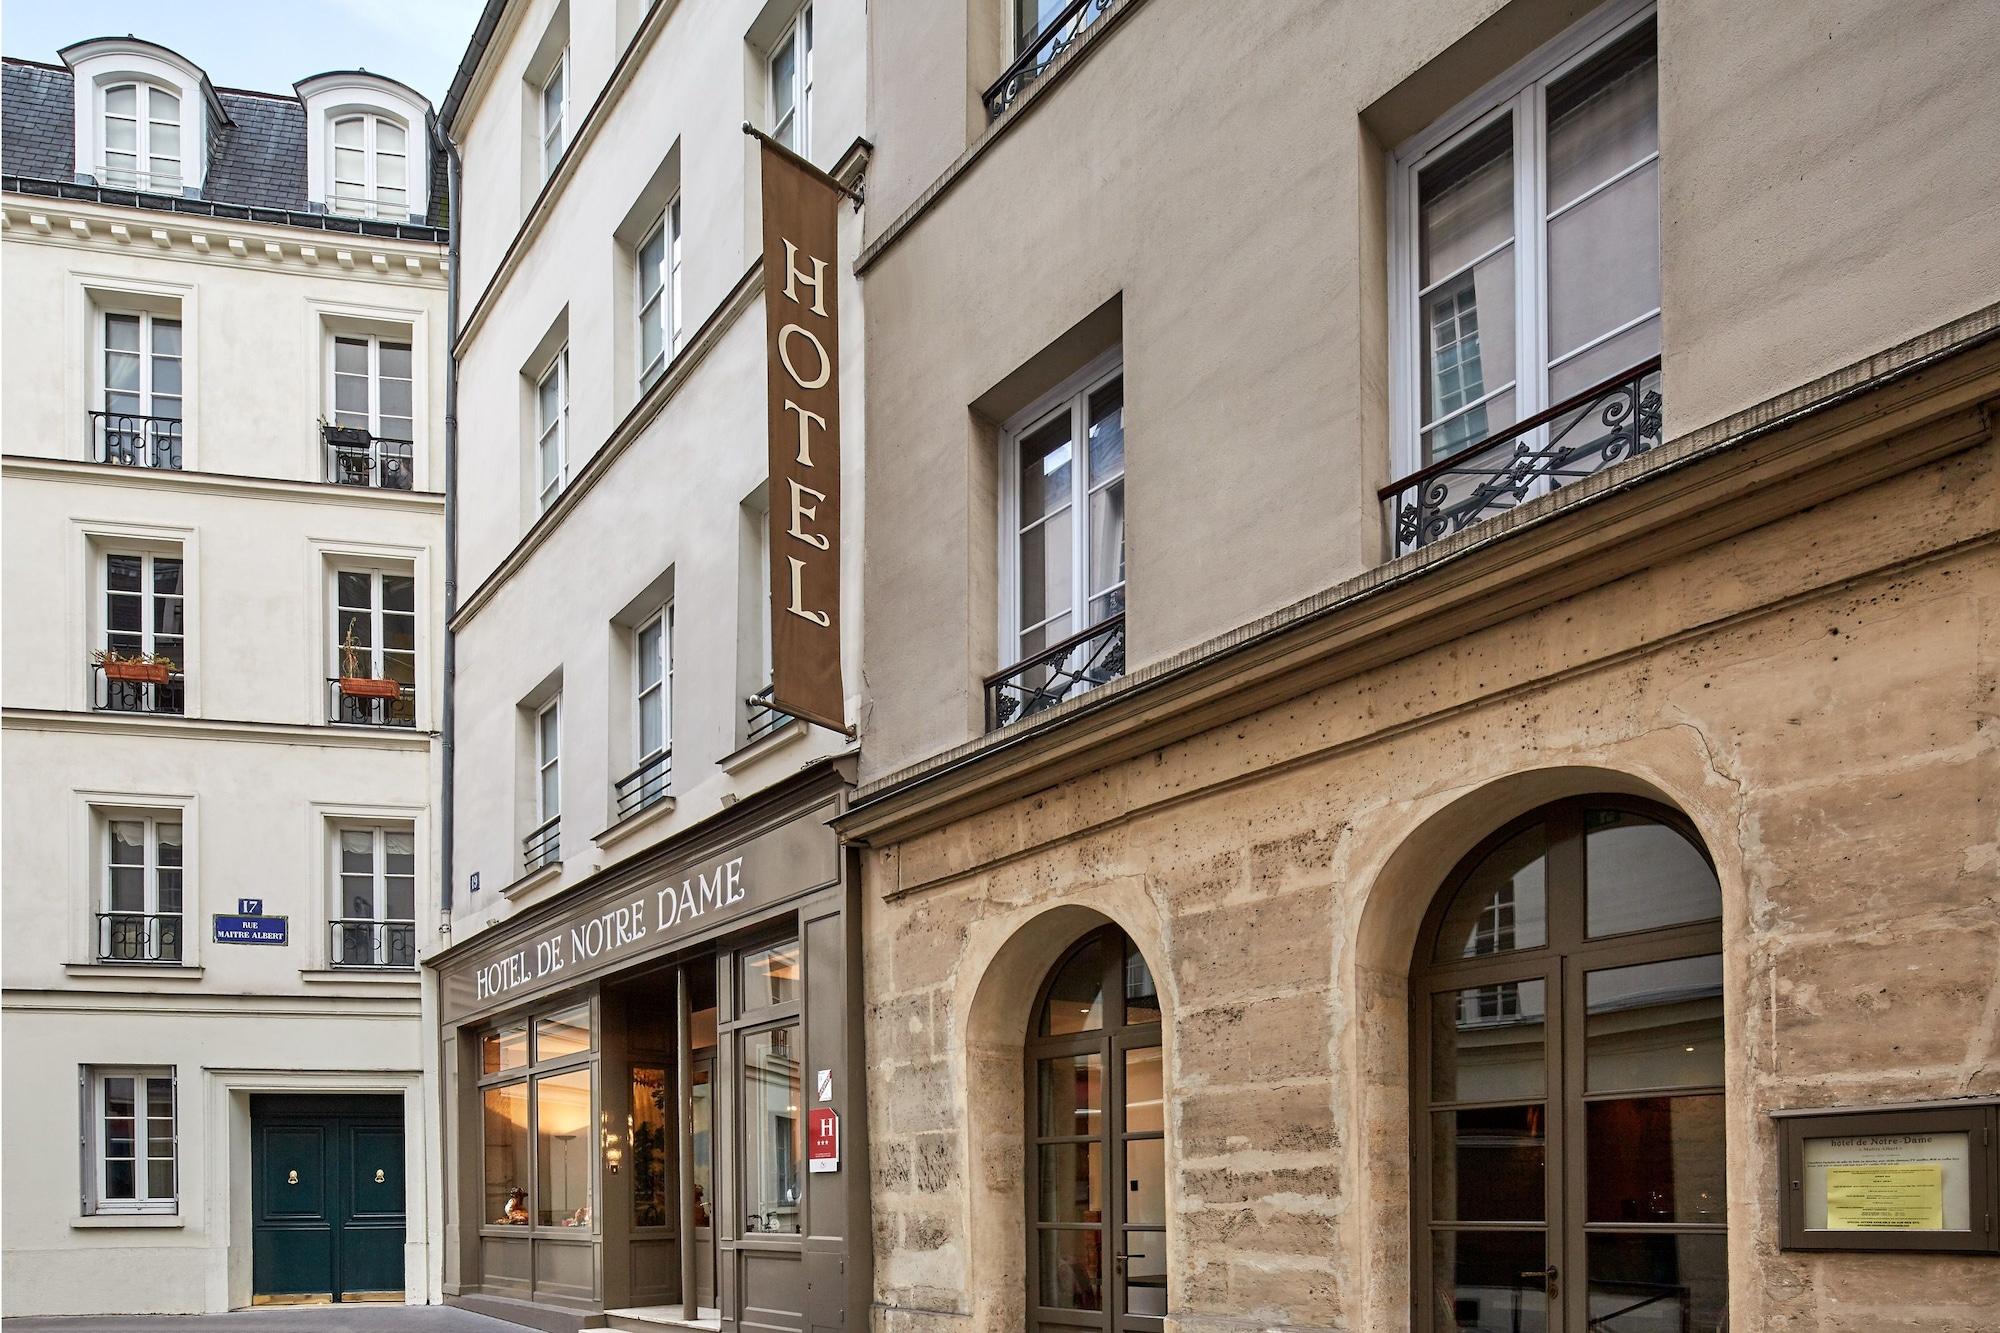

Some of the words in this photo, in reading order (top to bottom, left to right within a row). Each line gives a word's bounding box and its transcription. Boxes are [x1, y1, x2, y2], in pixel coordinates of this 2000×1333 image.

[777, 236, 831, 628] HOTEL
[471, 875, 478, 890] 19
[242, 900, 258, 913] 17
[242, 921, 259, 929] RUE
[476, 950, 532, 1001] HOTEL
[536, 934, 565, 978] DE
[570, 898, 647, 965] NOTRE
[656, 856, 746, 933] DAME
[217, 930, 250, 939] MAITRE
[251, 932, 284, 940] ALBERT
[820, 1117, 834, 1137] H
[1856, 1136, 1867, 1146] de
